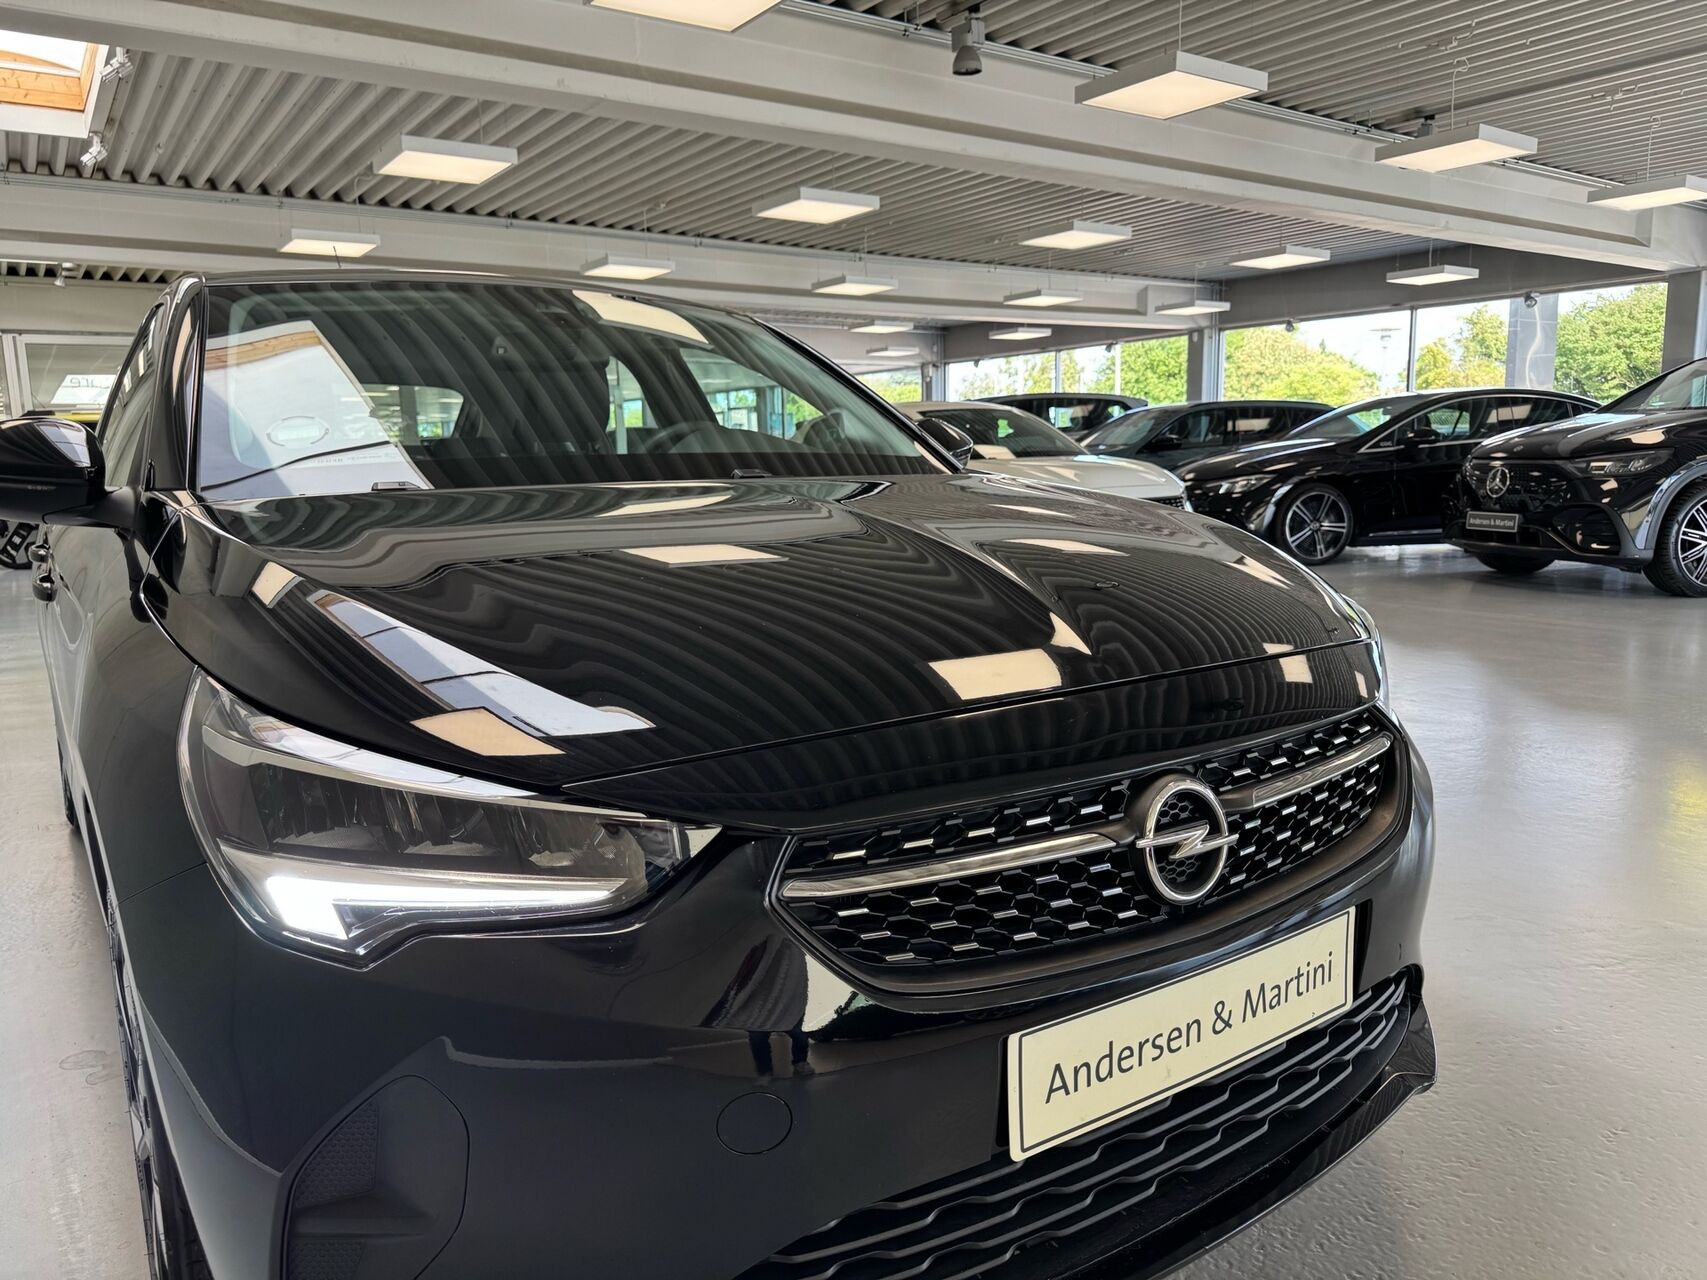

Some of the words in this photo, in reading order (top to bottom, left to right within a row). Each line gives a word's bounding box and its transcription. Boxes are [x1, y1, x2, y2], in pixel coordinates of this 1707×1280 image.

[1045, 1018, 1202, 1105] Andersen
[1211, 1000, 1233, 1036] &
[1241, 950, 1334, 1023] Martini
